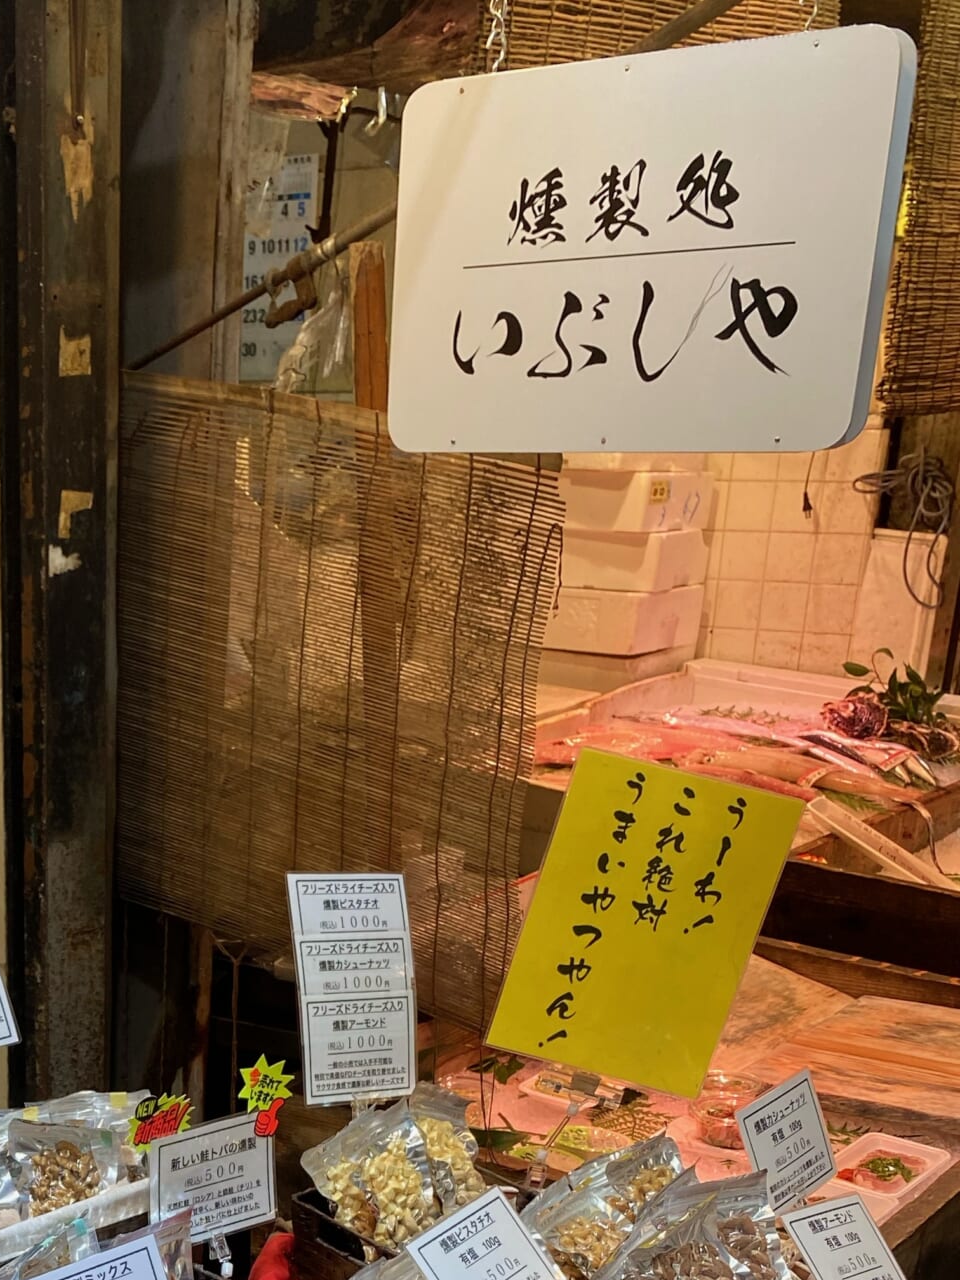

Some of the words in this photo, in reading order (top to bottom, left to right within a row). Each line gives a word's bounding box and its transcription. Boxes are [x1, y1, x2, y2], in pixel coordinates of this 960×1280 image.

[248, 241, 256, 255] 9
[262, 240, 275, 254] 10
[278, 240, 290, 253] 11
[294, 237, 308, 251] 12
[452, 266, 798, 382] いぶしや
[241, 343, 256, 357] 30
[632, 787, 695, 932] これ絶対
[302, 883, 396, 895] フリーズドライチーズ入り
[323, 899, 379, 910] 燻製ピスタチオ
[538, 772, 646, 1048] うまいやつやん！
[306, 943, 399, 956] フリーズドライチーズ入り
[319, 959, 390, 971] 燻製カシューナッツ
[313, 1001, 404, 1017] フリーズドライチーズ入り
[333, 1017, 386, 1032] 燻製アーモンド
[137, 1101, 155, 1118] NEW
[754, 1091, 807, 1135] 燻製カシューナッツ
[771, 1129, 786, 1145] 有塩
[789, 1120, 803, 1135] 100g
[171, 1137, 257, 1171] 新しい鮭トバの燻製
[808, 1210, 855, 1232] 燻製アーモンド
[439, 1211, 495, 1253] 燻製ピスタチオ
[824, 1236, 842, 1249] 有塩
[845, 1231, 861, 1245] 100g
[458, 1247, 480, 1266] 有塩
[482, 1235, 502, 1251] 100g
